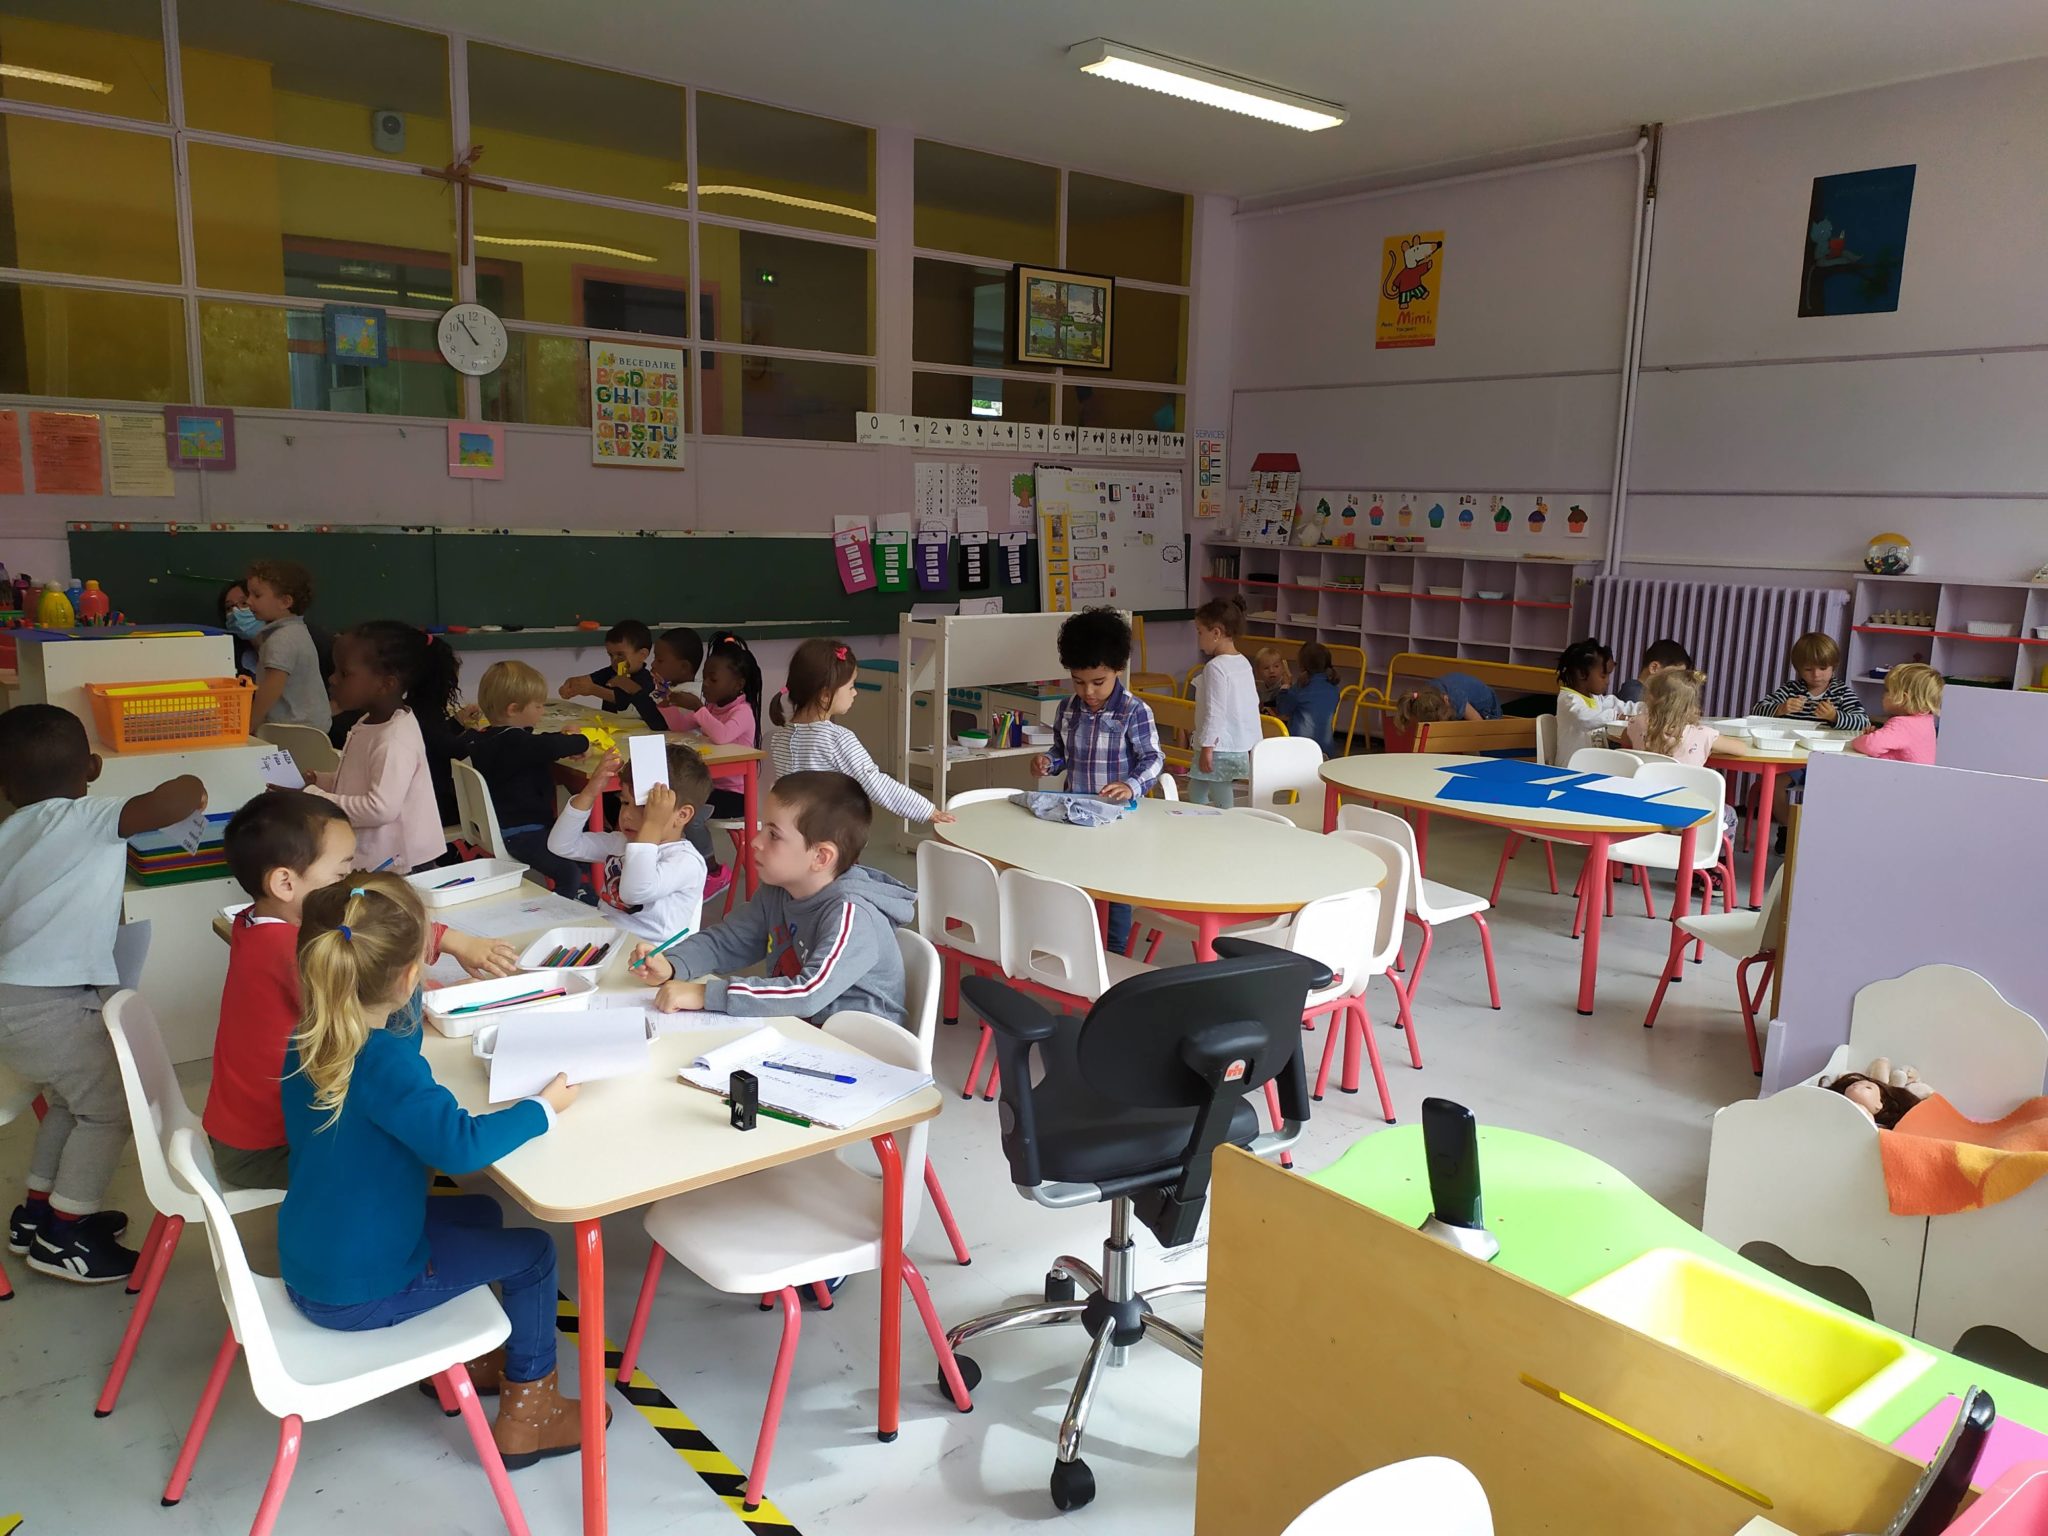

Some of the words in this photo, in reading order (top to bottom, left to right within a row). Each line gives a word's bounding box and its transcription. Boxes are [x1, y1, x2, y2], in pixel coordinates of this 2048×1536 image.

[468, 311, 478, 321] 12
[449, 322, 459, 332] 10
[489, 326, 497, 335] 2
[445, 333, 452, 343] 9
[619, 357, 677, 370] BECEDAIRE
[870, 416, 879, 430] 0
[900, 418, 905, 432] 1
[930, 421, 938, 435] 2
[963, 423, 969, 436] 3
[993, 425, 1000, 437] 4
[1024, 426, 1031, 439] 5
[1053, 428, 1060, 441] 6
[1082, 430, 1088, 443] 7
[1110, 432, 1117, 444] 8
[1137, 433, 1143, 446] 9
[1162, 434, 1171, 447] 10
